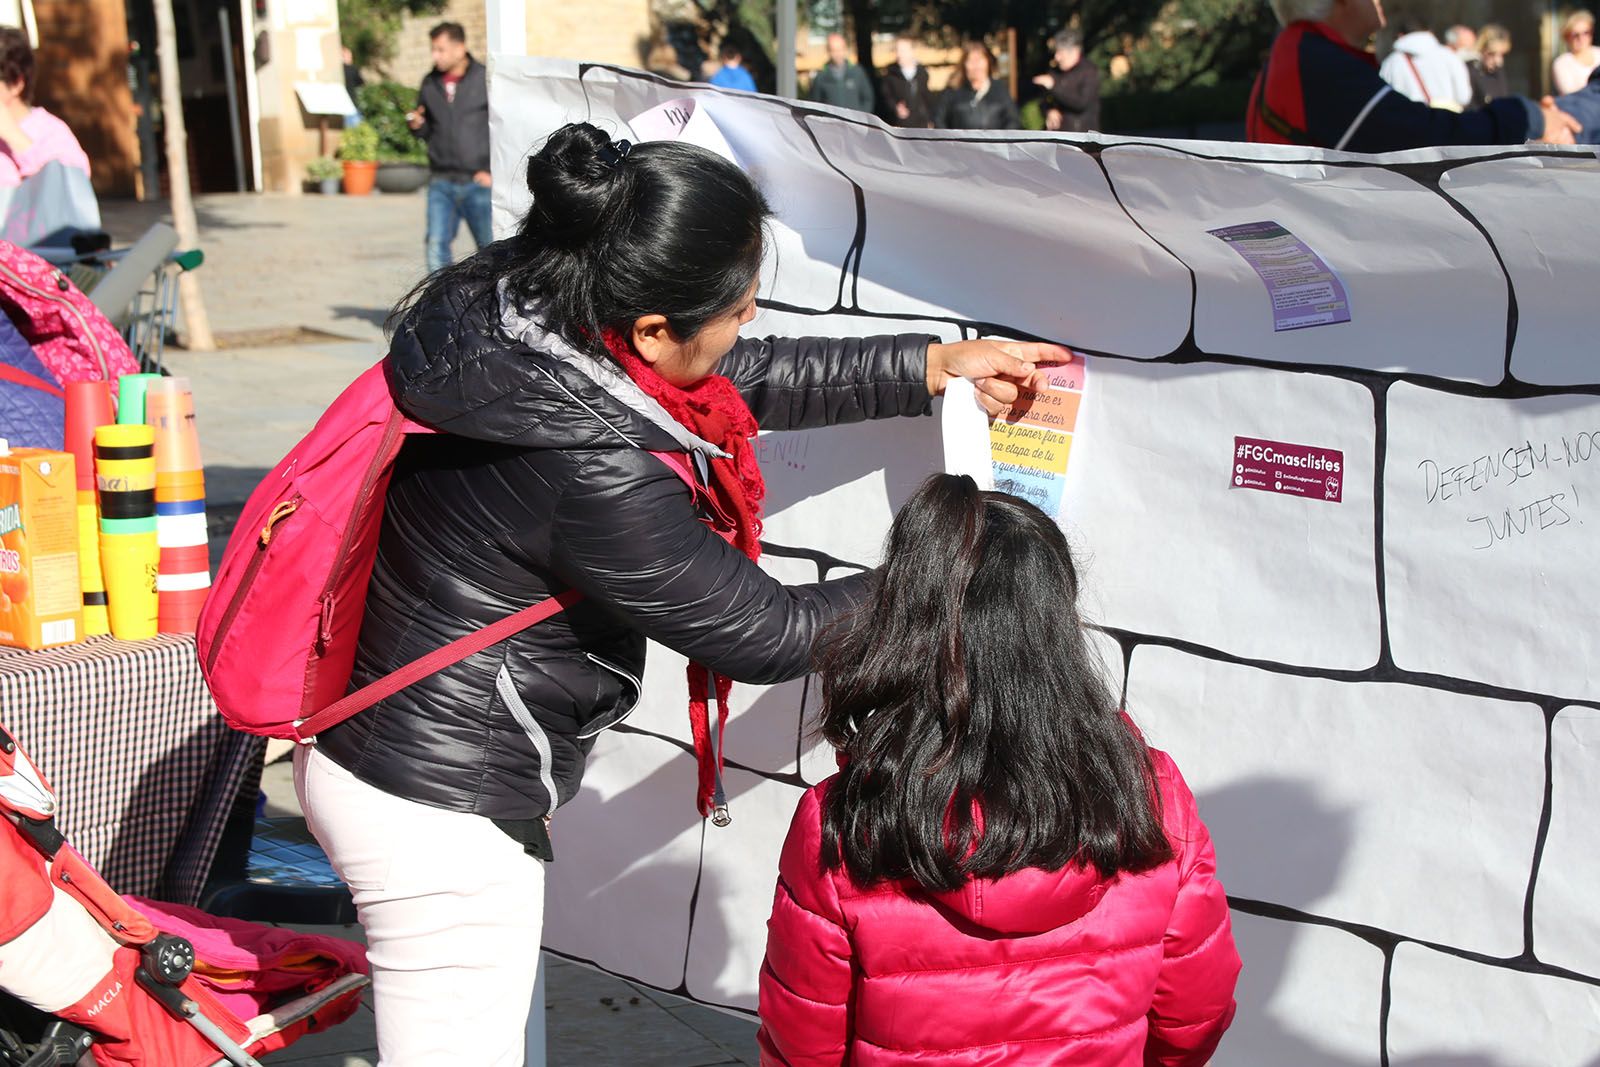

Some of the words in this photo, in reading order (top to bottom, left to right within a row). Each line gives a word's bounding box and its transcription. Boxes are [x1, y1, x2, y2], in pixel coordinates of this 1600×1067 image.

[1052, 396, 1064, 406] es
[1042, 411, 1066, 425] decir
[1007, 426, 1014, 438] y
[1015, 427, 1042, 440] poner
[1041, 430, 1057, 444] fin
[1058, 435, 1066, 444] a
[1005, 443, 1030, 457] etapa
[1032, 447, 1044, 458] de
[1044, 450, 1055, 461] tu
[1236, 444, 1341, 473] #FGCmasclistes
[998, 461, 1016, 474] que
[1016, 463, 1056, 480] hubieras
[1466, 484, 1583, 549] JUNTES!
